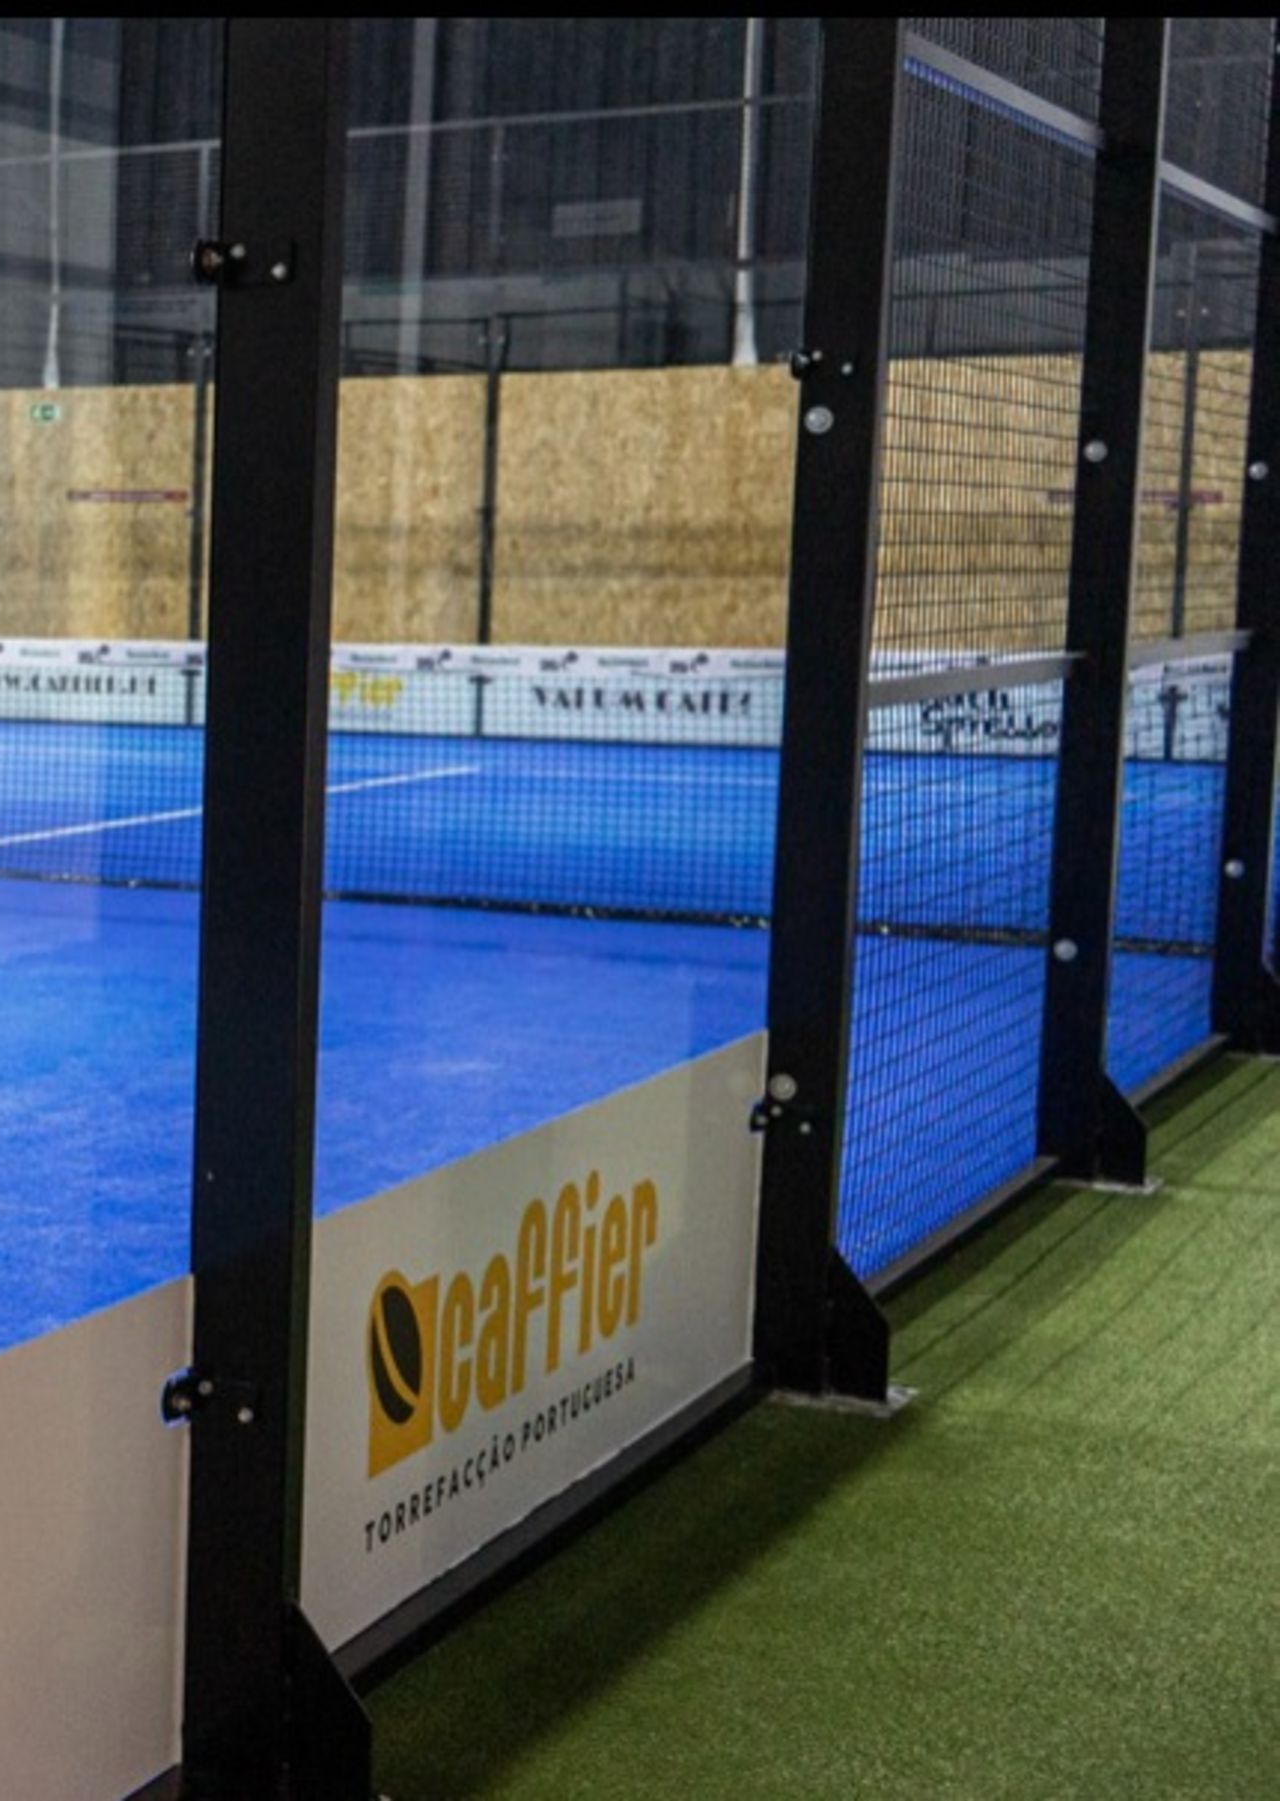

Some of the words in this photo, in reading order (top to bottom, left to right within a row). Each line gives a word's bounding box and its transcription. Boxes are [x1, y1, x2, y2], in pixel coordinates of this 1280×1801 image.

[439, 1169, 659, 1434] caffier
[364, 1433, 516, 1554] TORREFACÇÃO
[518, 1355, 636, 1455] PORTUGUESA
